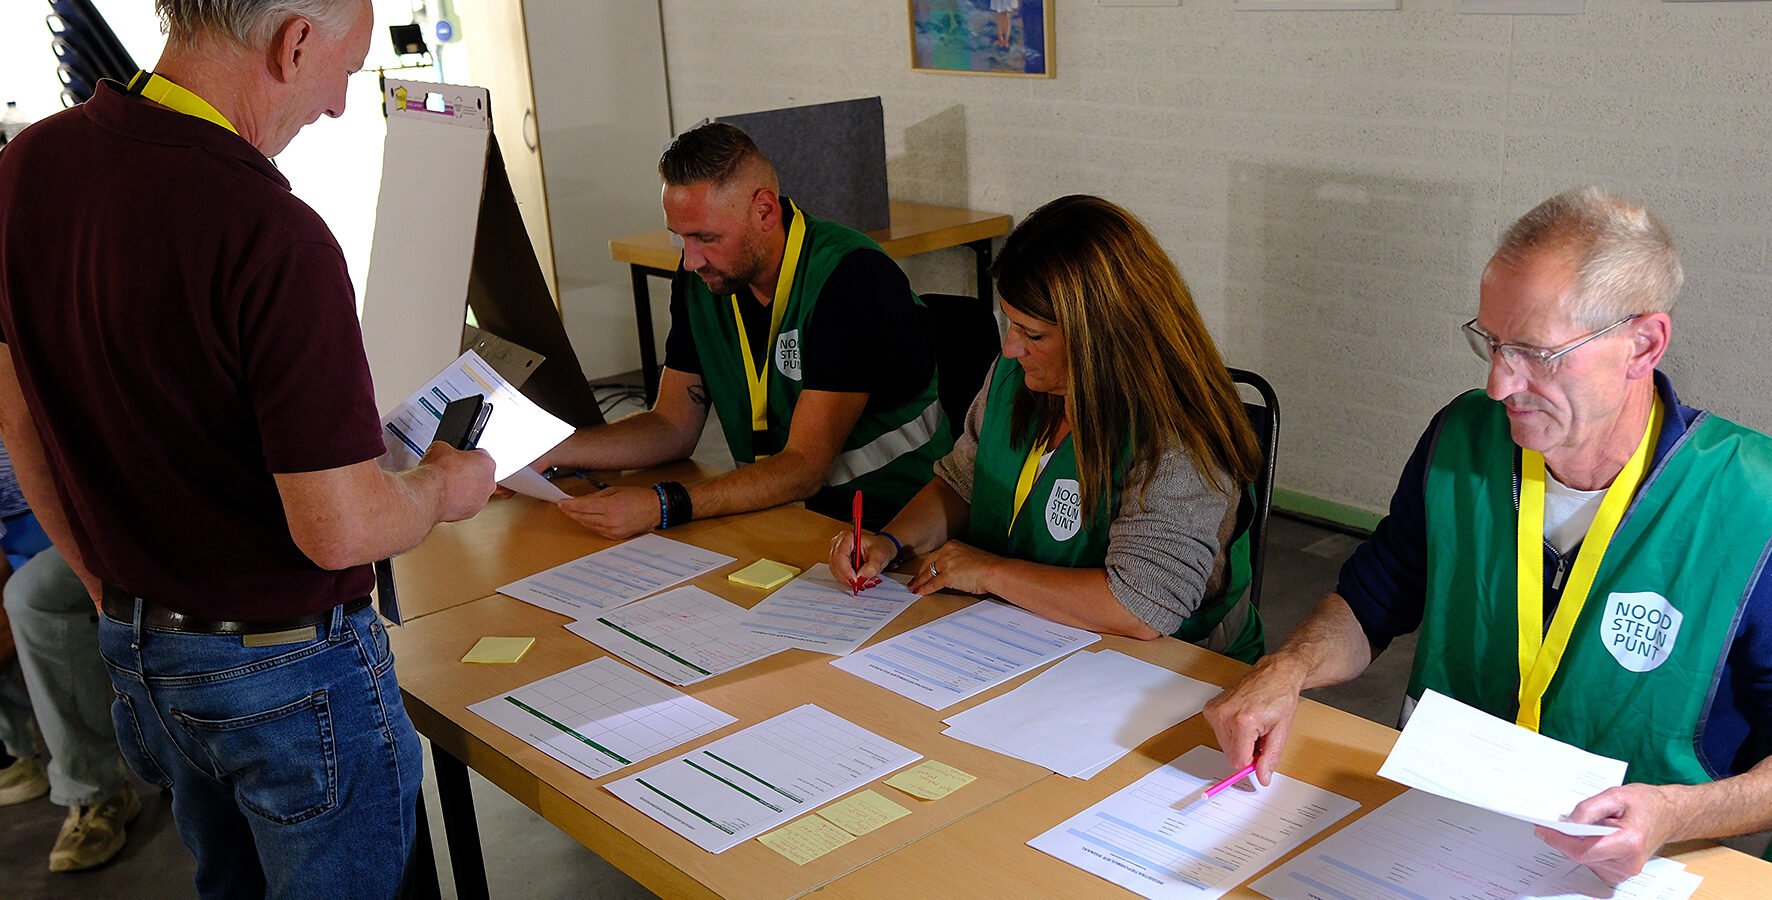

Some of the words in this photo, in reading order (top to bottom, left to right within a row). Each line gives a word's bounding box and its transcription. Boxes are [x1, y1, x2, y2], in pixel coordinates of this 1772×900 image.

[780, 338, 799, 350] NO
[780, 350, 800, 360] STE
[1051, 499, 1079, 521] STEUN
[1050, 512, 1075, 531] PUNT
[1615, 602, 1672, 630] NOOD
[1611, 618, 1667, 648] STEUN
[1613, 633, 1660, 661] PUNT
